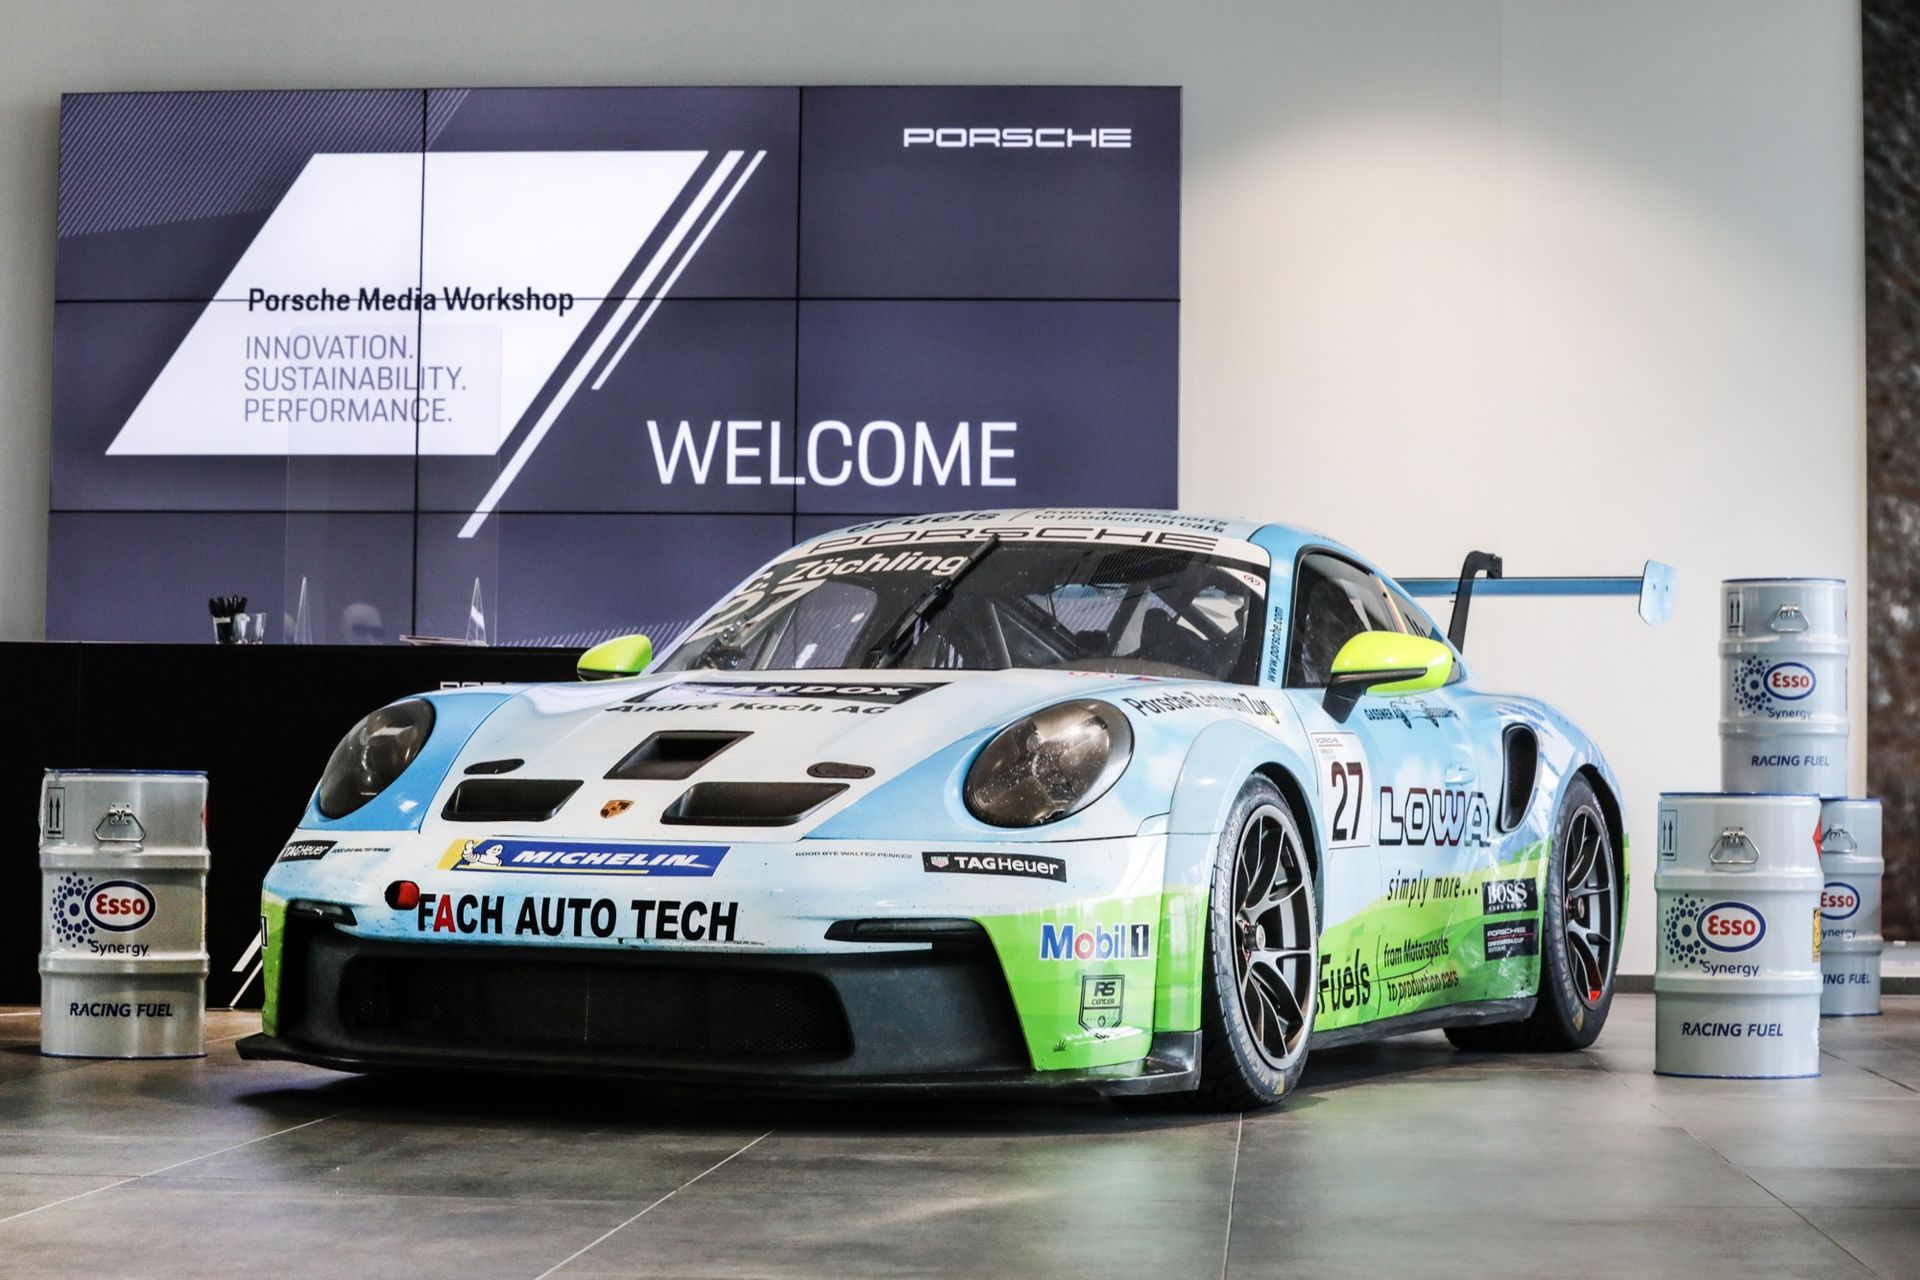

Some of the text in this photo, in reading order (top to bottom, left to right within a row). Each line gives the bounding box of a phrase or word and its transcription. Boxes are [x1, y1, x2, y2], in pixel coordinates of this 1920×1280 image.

[903, 127, 1133, 148] PORSCHE
[248, 286, 574, 317] Porsche Media Workshop
[245, 334, 414, 360] INNOVATION.
[244, 365, 467, 391] SUSTAINABILITY.
[244, 397, 453, 423] PERFORMANCE.
[646, 420, 1018, 487] WELCOME
[1058, 513, 1174, 526] production
[808, 527, 1219, 554] PORSCHE
[778, 551, 969, 585] Zöchling
[1267, 605, 1284, 683] www.porsche.com
[1772, 671, 1810, 688] Esso
[605, 701, 892, 716] André Koch AG
[1122, 692, 1191, 716] Porsche
[1768, 707, 1814, 721] Synergy
[1751, 755, 1830, 767] RACING FUEL
[1330, 761, 1364, 842] 27
[1378, 786, 1491, 847] LOWA
[512, 850, 713, 868] MICHELIN
[1387, 869, 1478, 908] simply more...
[1487, 882, 1528, 905] BOSS
[96, 894, 146, 915] Esso
[417, 893, 739, 942] FACH AUTO TECH
[1708, 915, 1757, 936] Esso
[1041, 925, 1126, 960] Mobil
[1821, 928, 1857, 940] ynergy
[90, 941, 149, 957] Synergy
[1383, 936, 1449, 968] from Motorsports
[1702, 960, 1760, 977] Synergy
[1849, 973, 1871, 985] FUEL
[1094, 981, 1116, 997] RS
[1316, 948, 1371, 1014] Fuels
[1387, 969, 1459, 1006] to production cars
[69, 1002, 174, 1018] RACING FUEL
[1681, 1023, 1784, 1037] RACING FUEL
